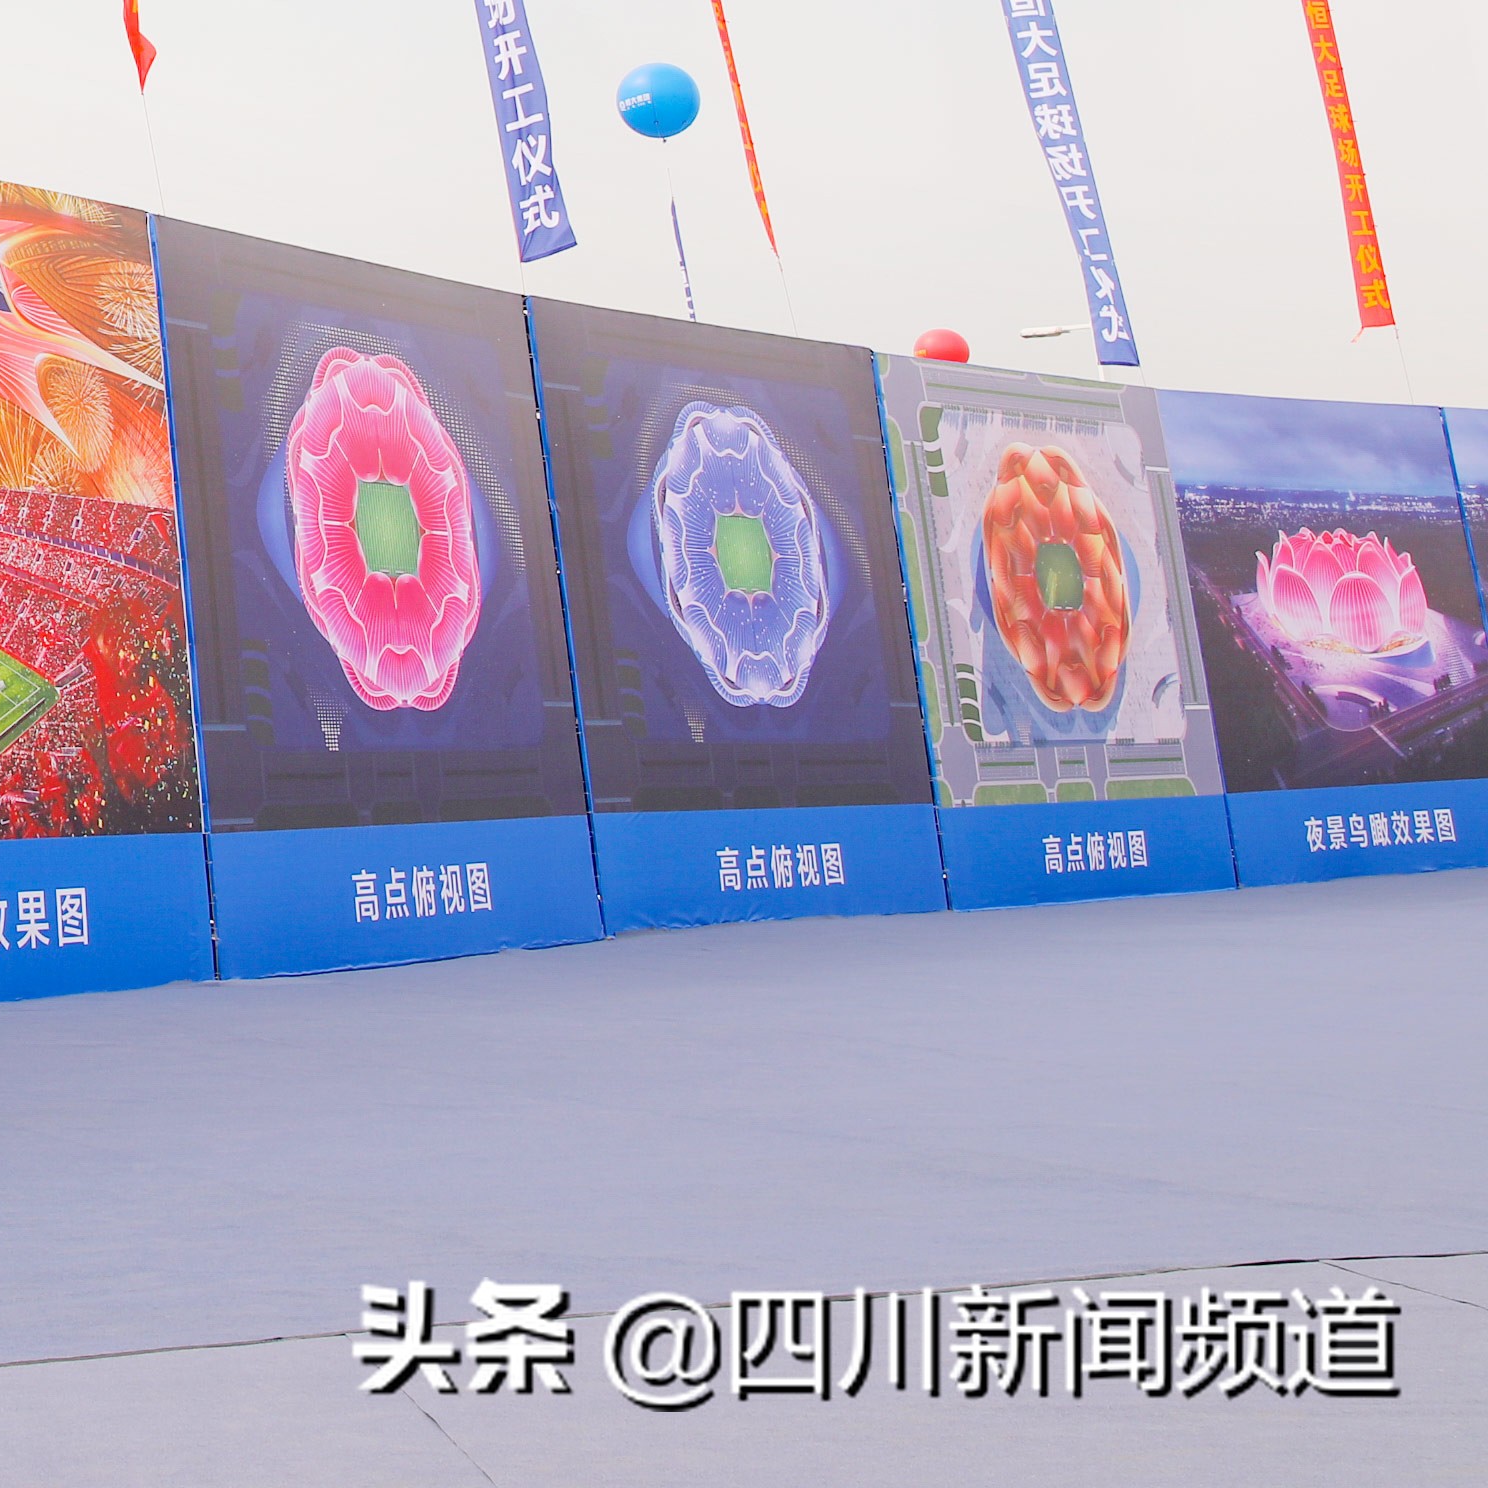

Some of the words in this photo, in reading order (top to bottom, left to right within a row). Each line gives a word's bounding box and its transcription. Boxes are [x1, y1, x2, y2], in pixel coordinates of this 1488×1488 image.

[1042, 830, 1148, 874] 高点俯视图
[1304, 808, 1457, 853] 夜景鸟瞰效果图
[716, 842, 845, 892] 高点俯视图
[351, 862, 493, 923] 高点俯视图
